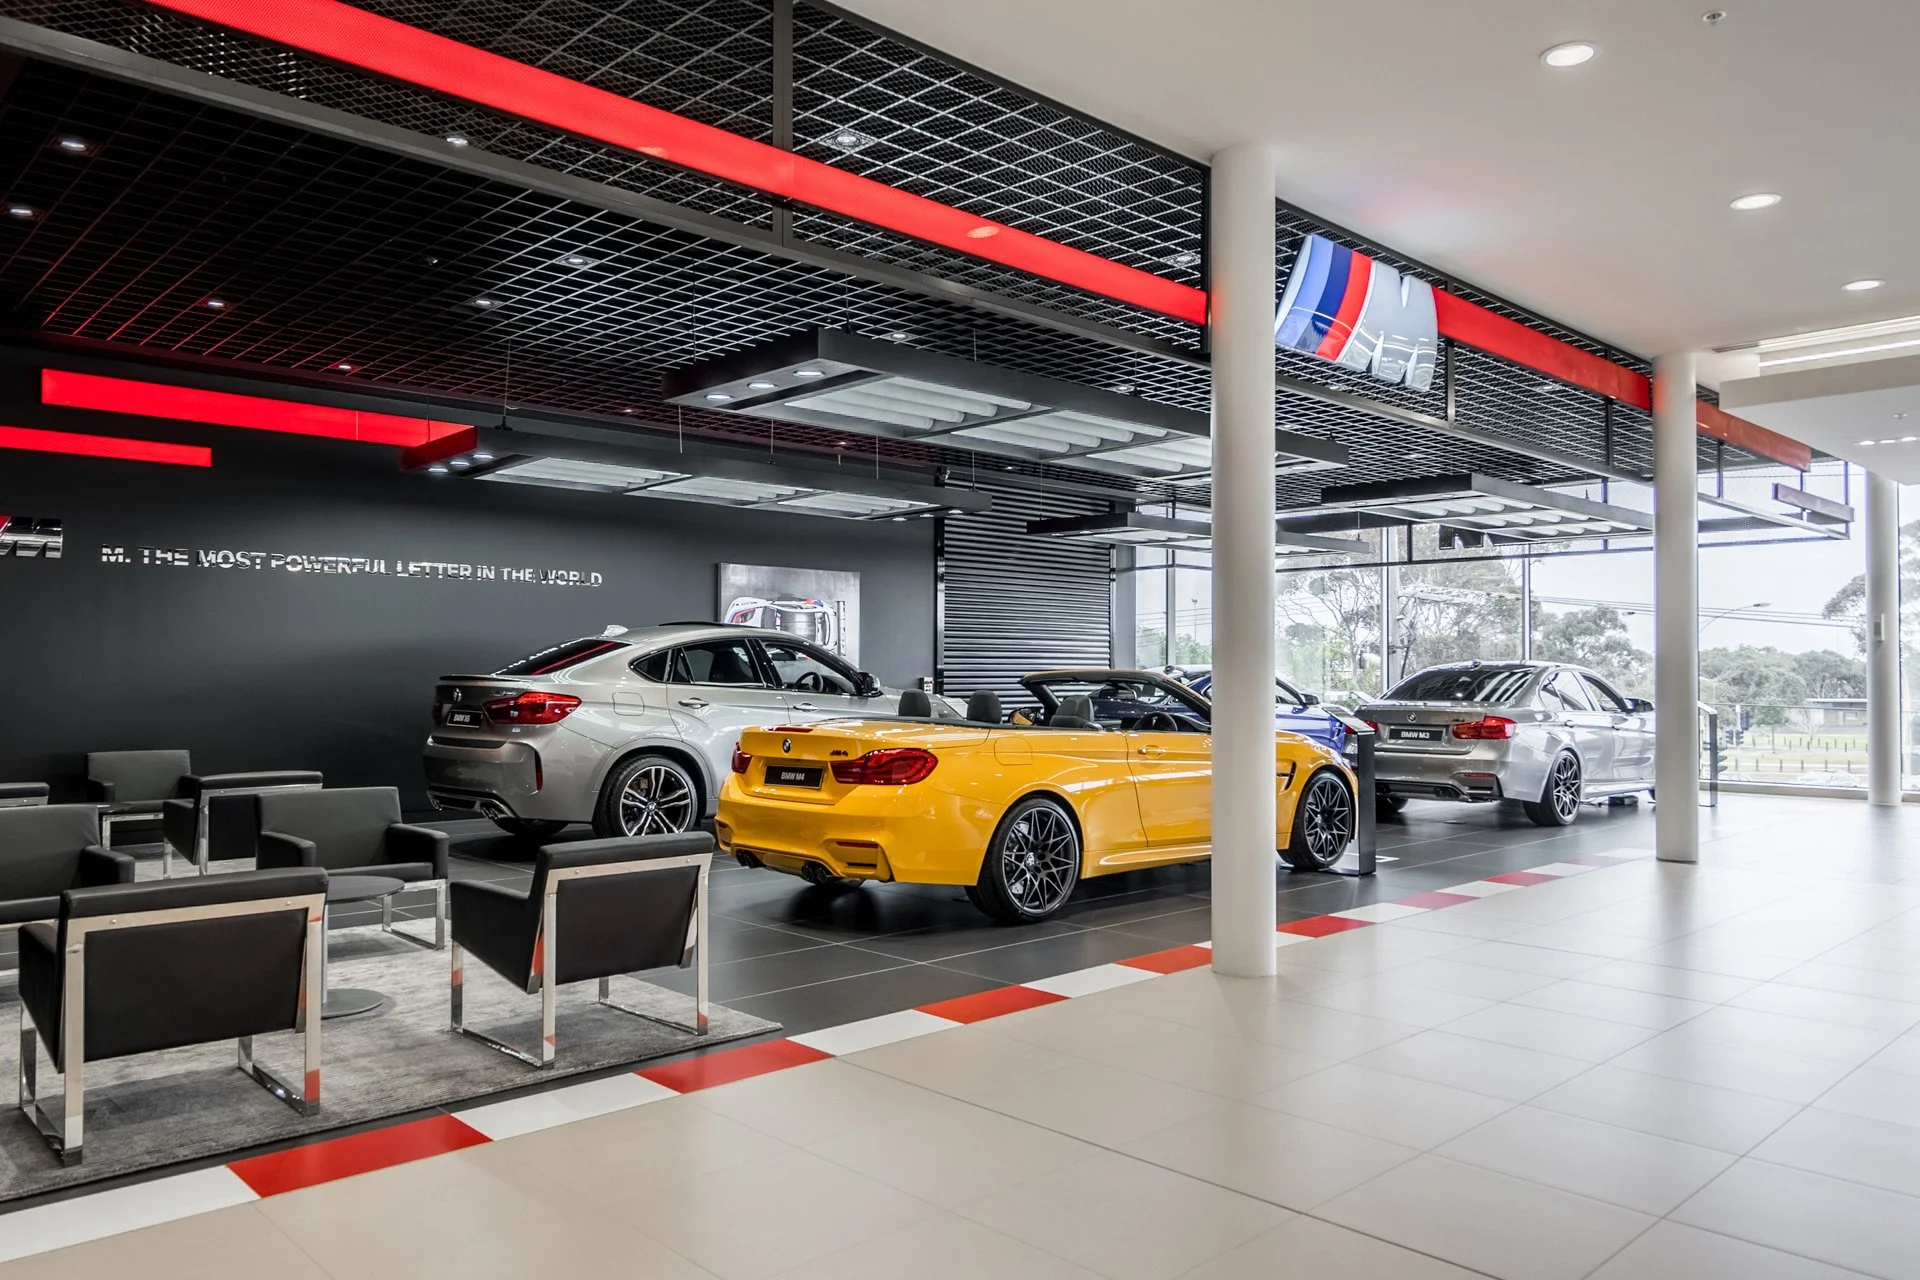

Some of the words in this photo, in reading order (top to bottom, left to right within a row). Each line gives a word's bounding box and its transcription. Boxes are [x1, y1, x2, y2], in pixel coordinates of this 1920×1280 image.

[101, 544, 132, 564] M.
[138, 545, 190, 566] THE
[196, 549, 267, 570] MOST
[270, 553, 392, 577] POWERFUL
[396, 560, 473, 580] LETTER
[477, 564, 496, 581] IN
[500, 567, 536, 584] THE
[539, 568, 603, 588] WORLD
[780, 772, 796, 780] BMW
[795, 772, 805, 781] M4
